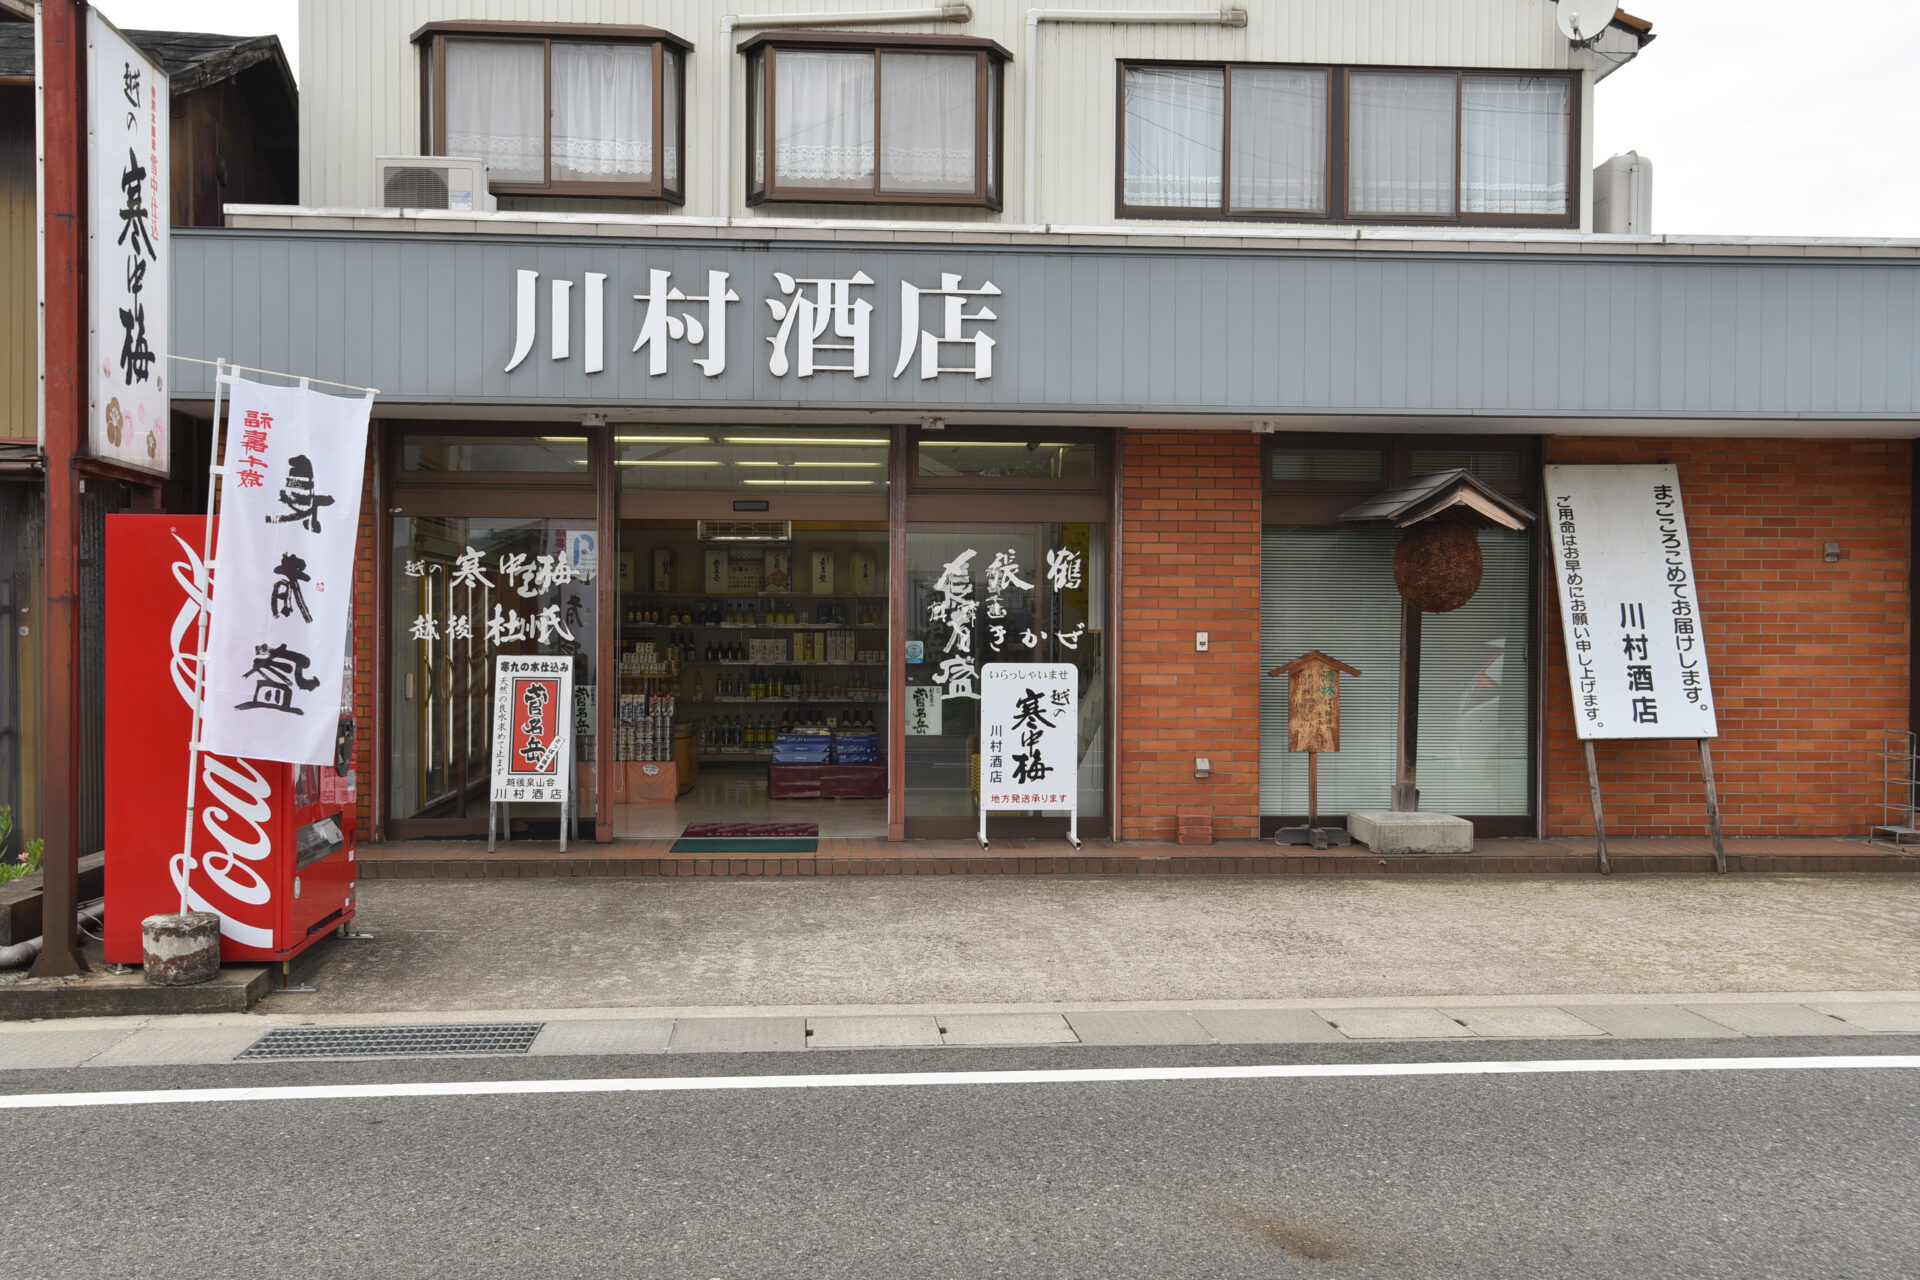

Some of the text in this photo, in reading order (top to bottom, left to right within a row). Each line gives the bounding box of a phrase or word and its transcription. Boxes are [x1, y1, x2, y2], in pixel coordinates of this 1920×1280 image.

[117, 61, 157, 386] 越の寒中梅
[504, 268, 1002, 380] 川村酒店
[408, 603, 575, 646] 越後杜氏
[1556, 495, 1604, 728] ご用命はお早めにお願い申し上げます。
[1653, 484, 1708, 711] まごころこめてお届けします。
[500, 661, 569, 674] 寒九の水仕込み
[989, 669, 1069, 681] いらっしゃいませ
[1620, 602, 1658, 725] 川村酒店
[520, 683, 548, 762] 菅名岳
[1011, 687, 1056, 785] 寒中梅
[1050, 688, 1070, 718] 越の
[989, 724, 1003, 784] 川村酒店
[494, 788, 562, 800] 川村酒店
[991, 793, 1068, 805] 地方発送承ります
